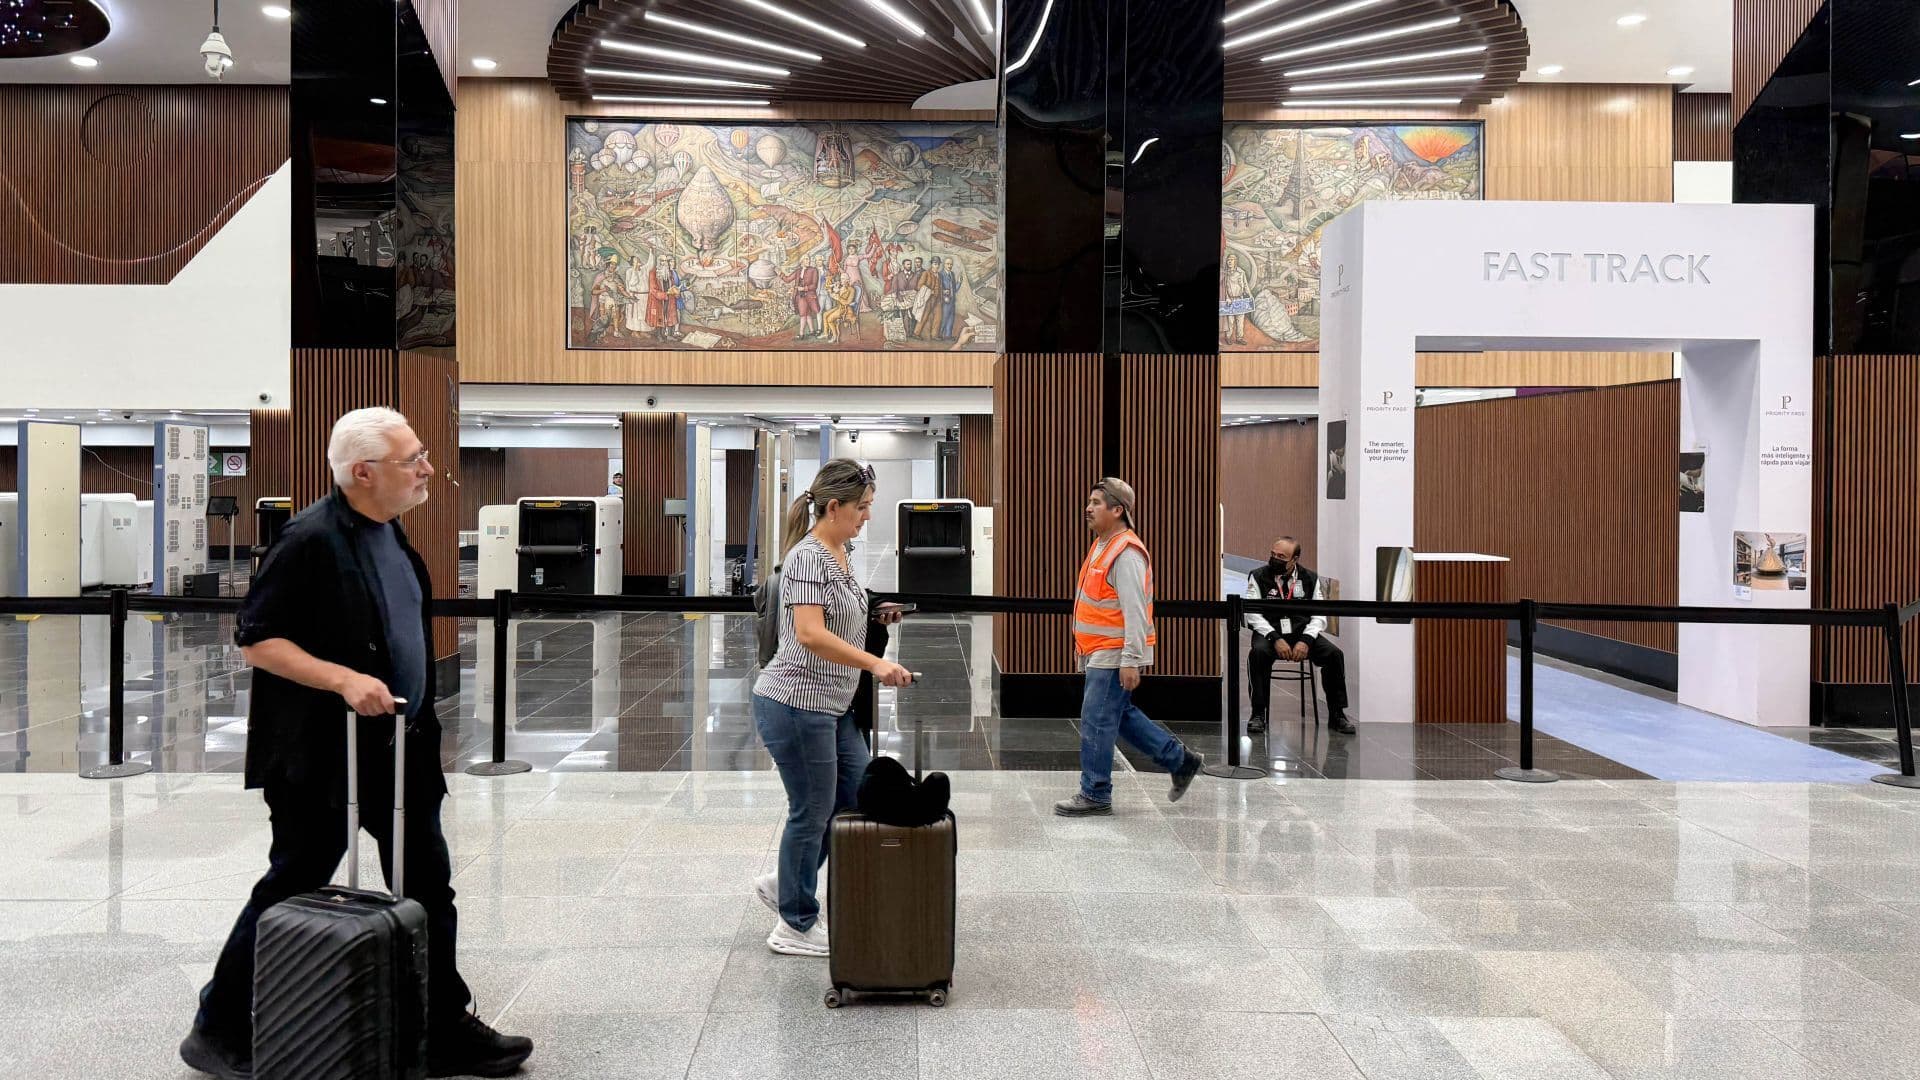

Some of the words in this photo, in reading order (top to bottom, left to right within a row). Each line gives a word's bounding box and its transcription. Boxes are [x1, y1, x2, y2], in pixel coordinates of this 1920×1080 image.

[1484, 252, 1571, 281] FAST
[1584, 253, 1710, 284] TRACK
[1382, 391, 1393, 405] P
[1781, 395, 1792, 410] P
[1775, 452, 1806, 460] inteligente
